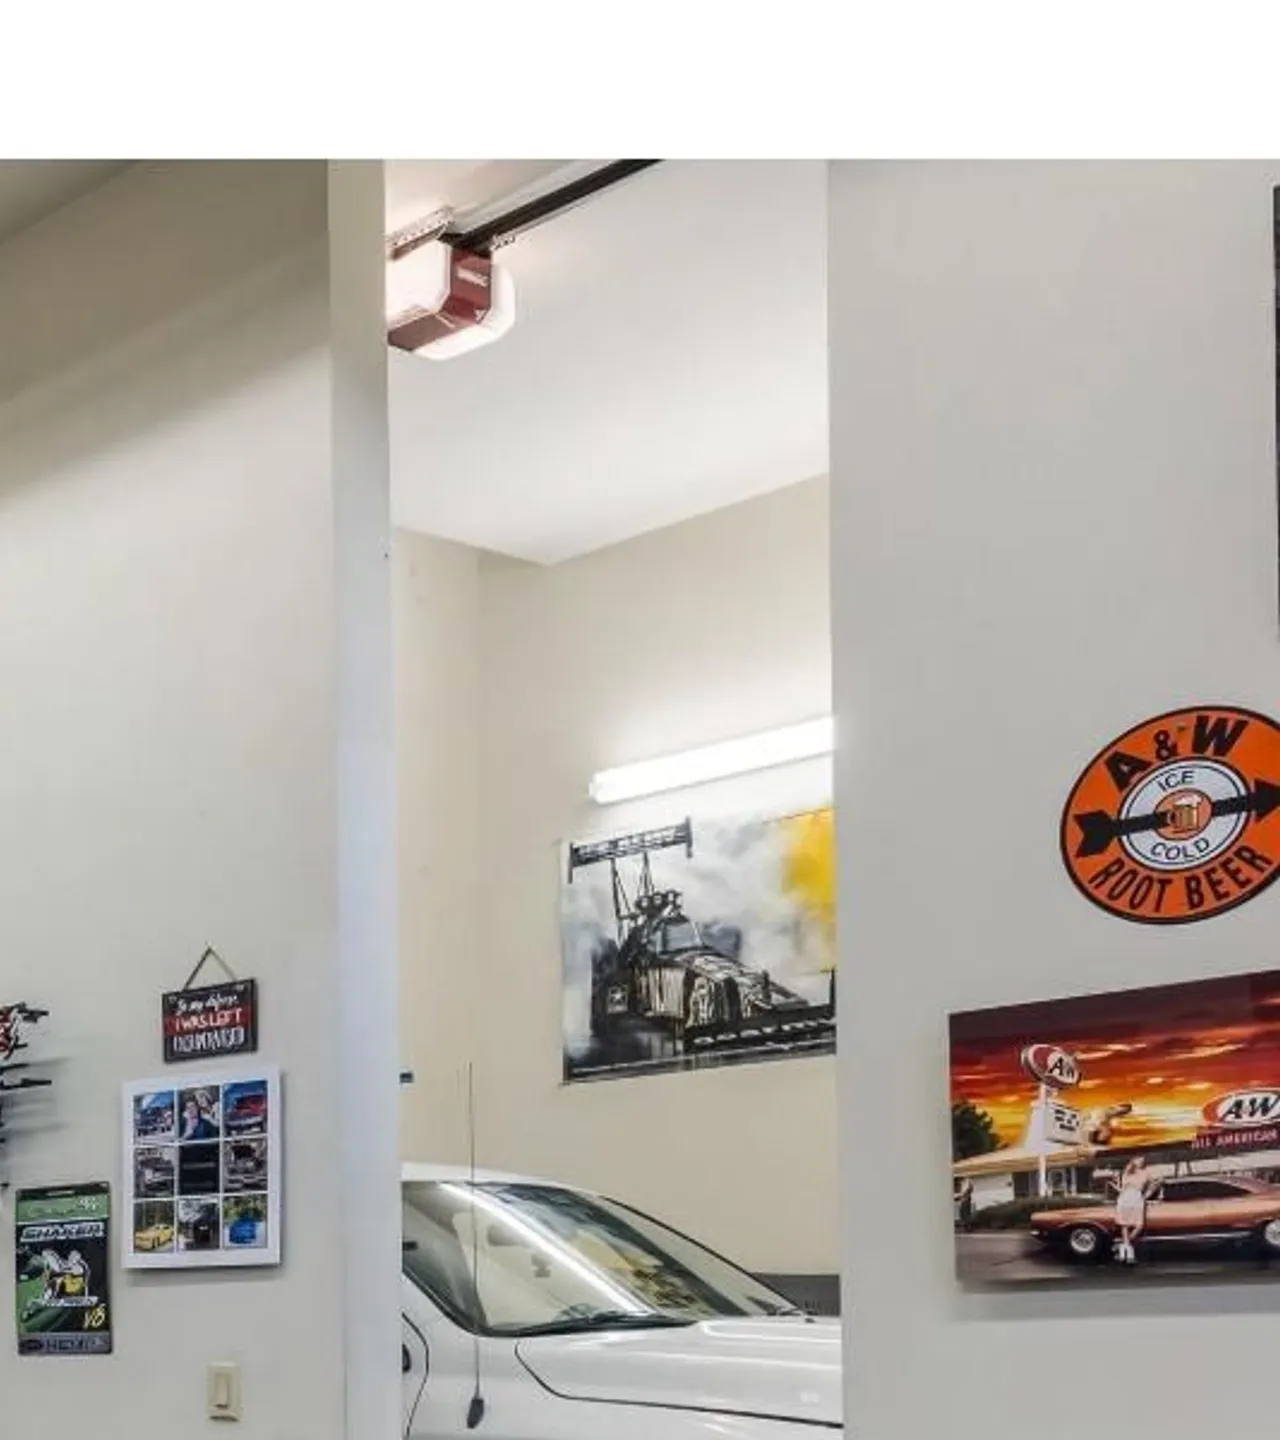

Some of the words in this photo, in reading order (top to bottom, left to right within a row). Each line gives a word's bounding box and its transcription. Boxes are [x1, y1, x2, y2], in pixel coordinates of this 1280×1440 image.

[1158, 770, 1195, 791] ICE
[1150, 837, 1209, 860] COLD
[1088, 857, 1173, 912] ROOT
[1184, 845, 1273, 909] BEER
